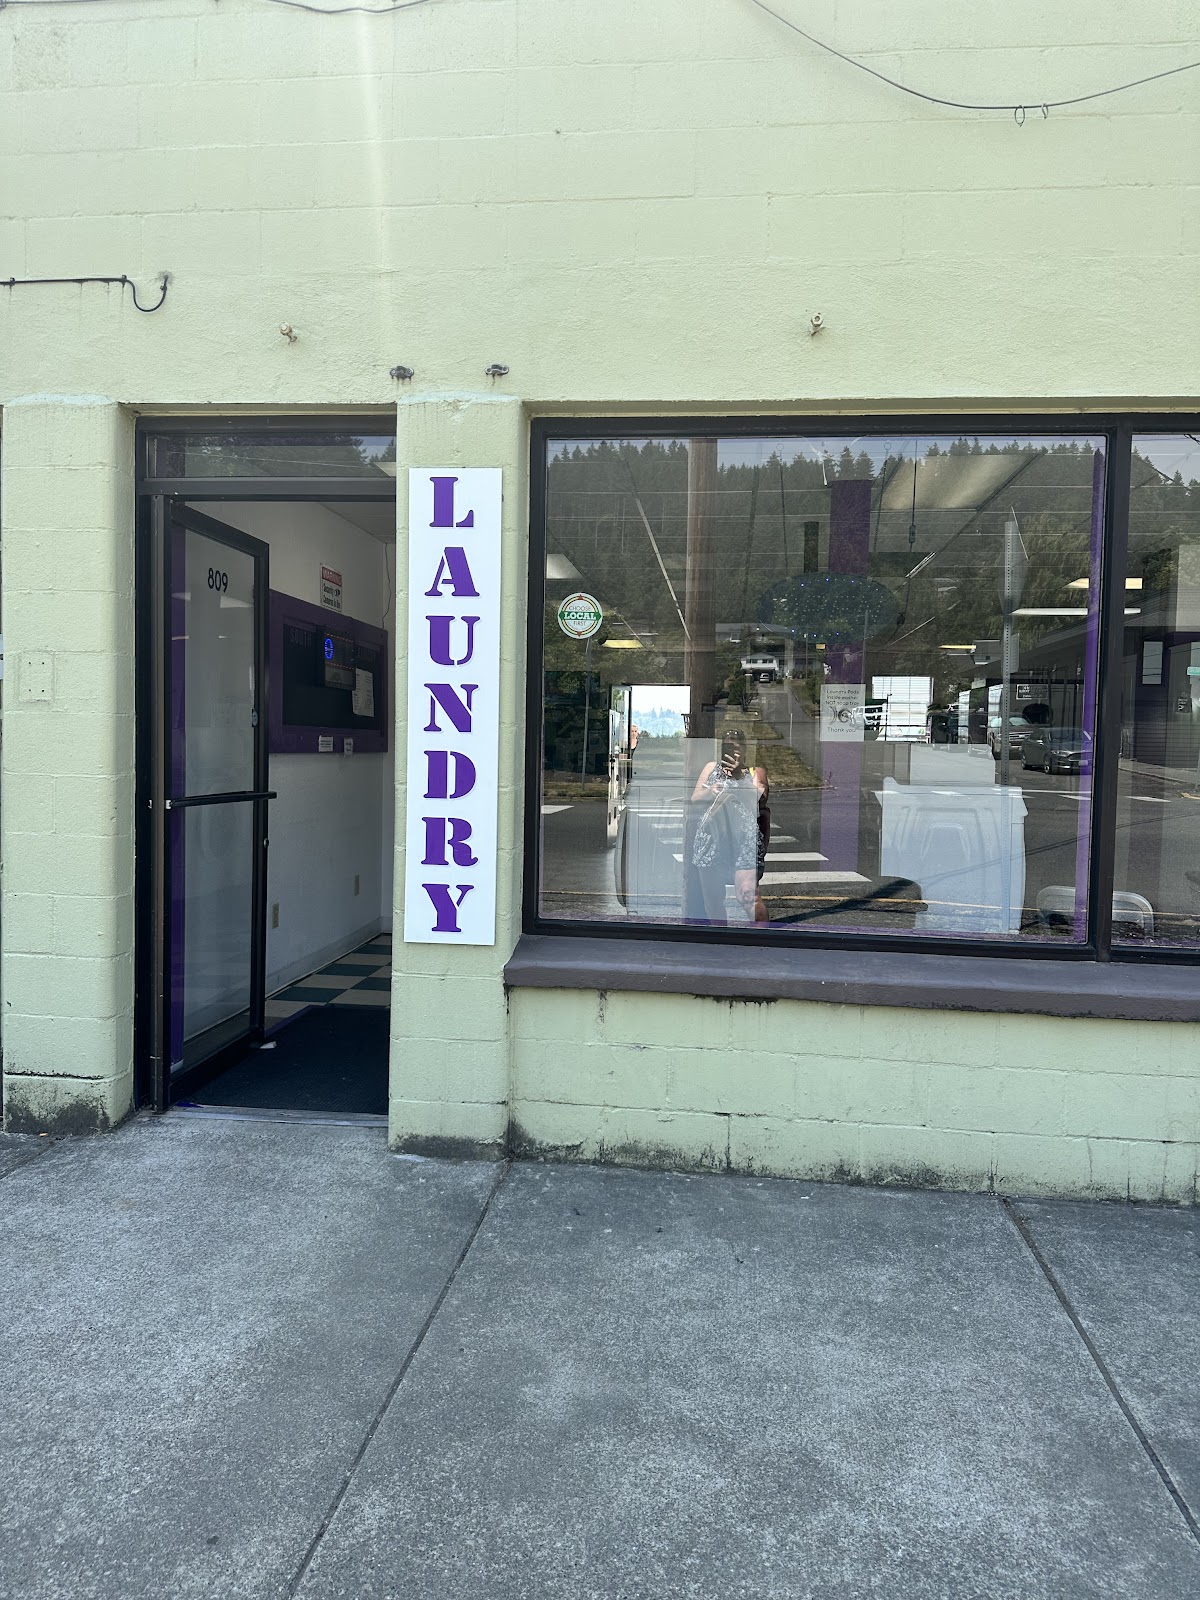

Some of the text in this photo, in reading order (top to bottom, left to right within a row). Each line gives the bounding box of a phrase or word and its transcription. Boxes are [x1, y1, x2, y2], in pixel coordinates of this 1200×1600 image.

[207, 567, 229, 594] 809
[322, 569, 341, 586] WARNING
[564, 612, 596, 620] LOCAL
[421, 476, 480, 933] LAUNDRY
